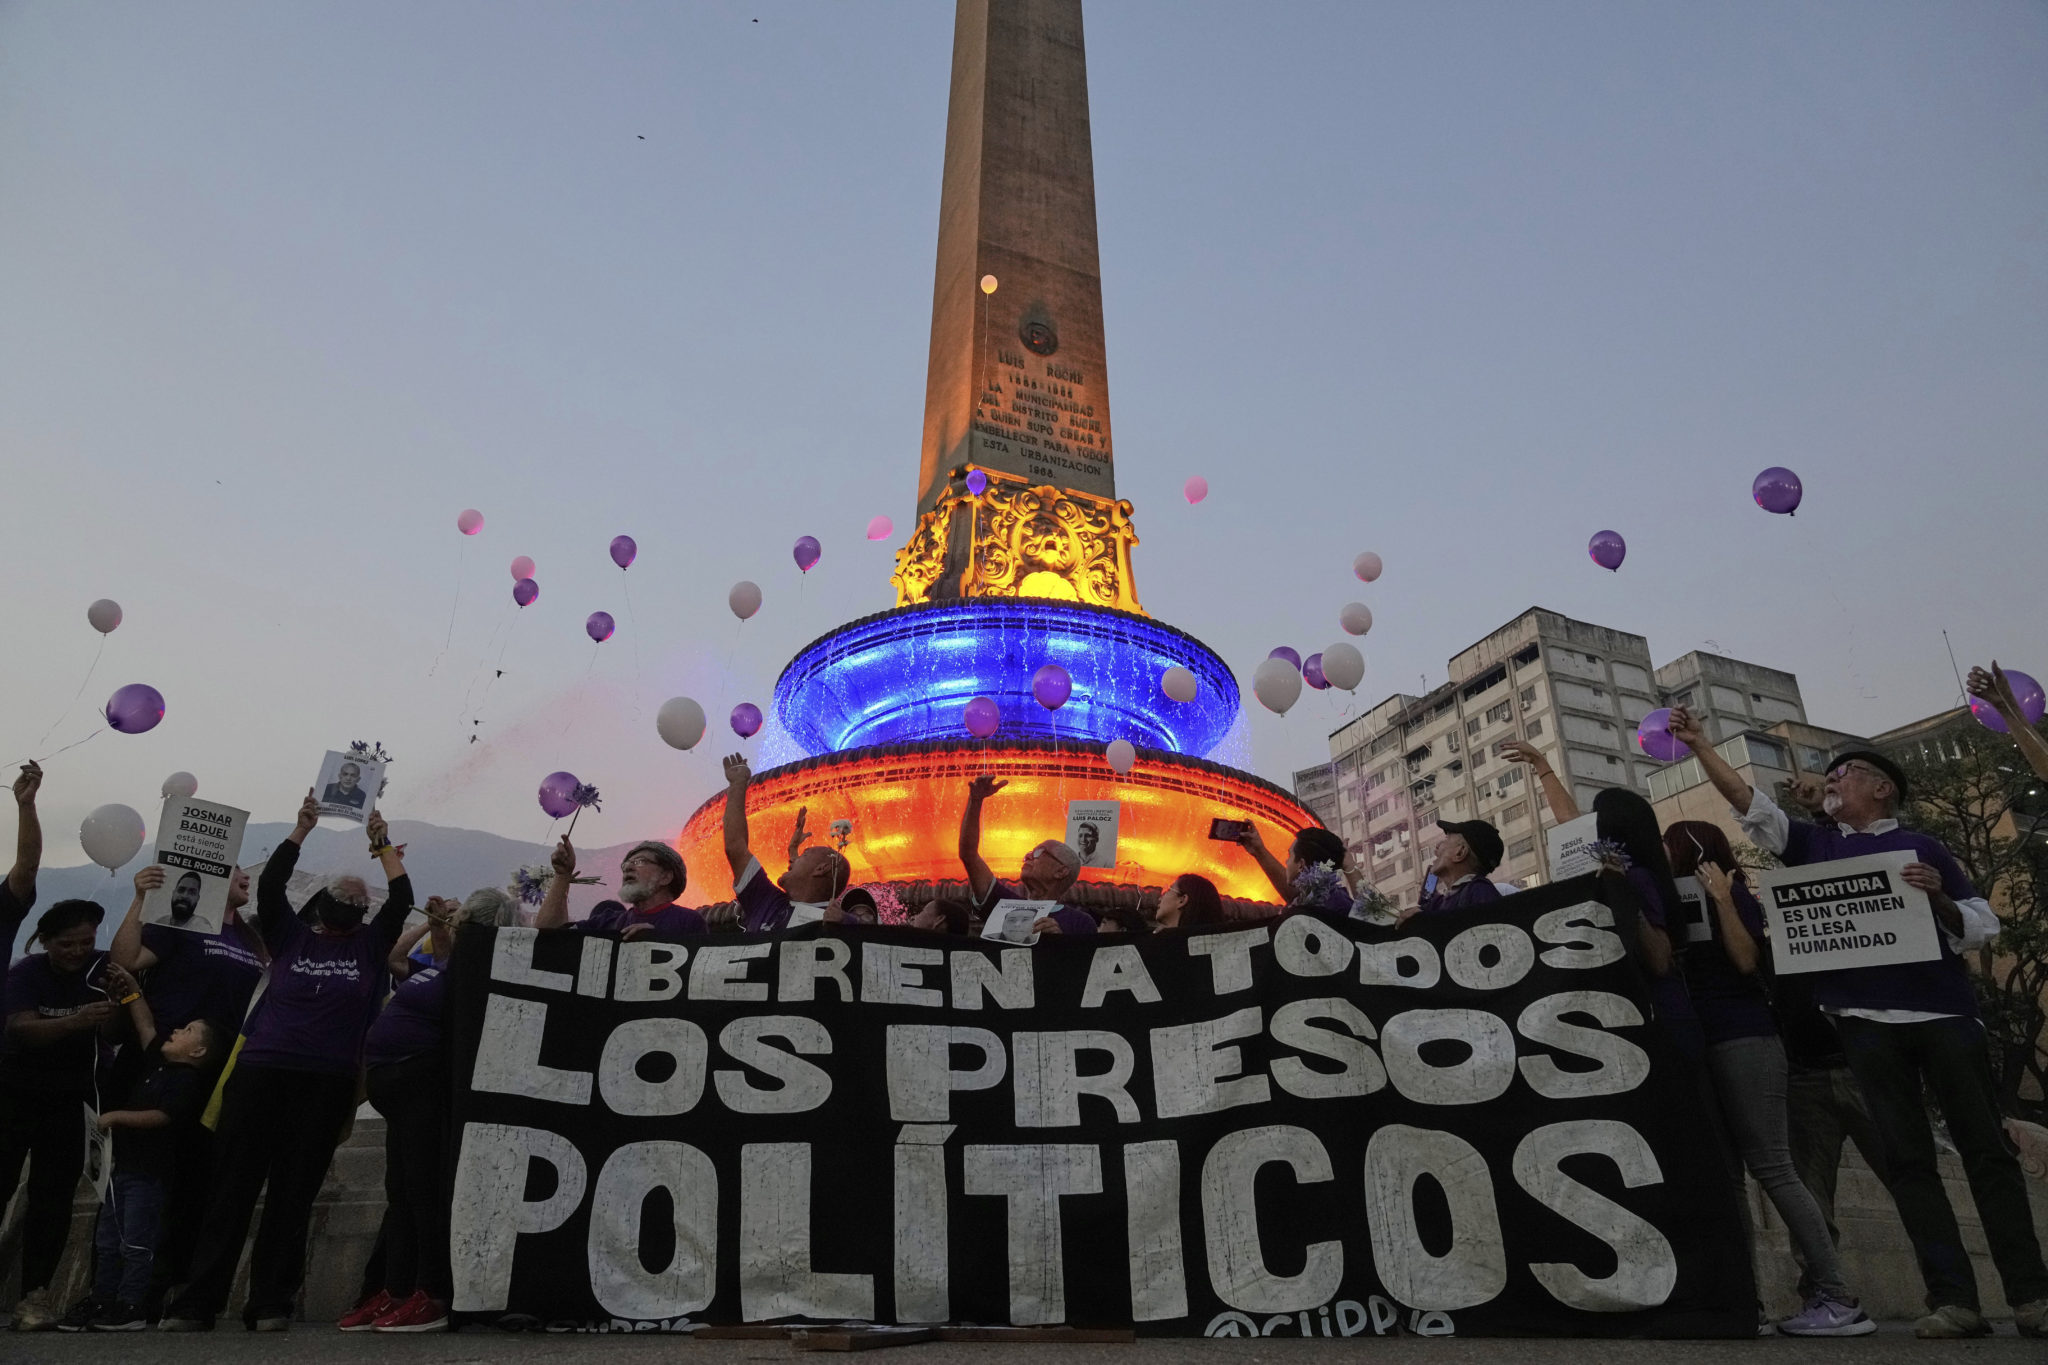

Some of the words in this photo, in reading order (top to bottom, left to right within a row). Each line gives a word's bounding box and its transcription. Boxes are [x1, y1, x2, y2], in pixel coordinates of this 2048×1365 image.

[998, 351, 1025, 369] LUIS
[1046, 363, 1084, 385] ROCHE
[1012, 402, 1059, 423] DISTRITO
[1015, 389, 1095, 417] MUNICIPALIDAD
[990, 408, 1021, 427] QUIEN
[1027, 421, 1054, 436] SUPO
[1060, 430, 1094, 445] CREAR
[975, 422, 1038, 446] EMBELLECER
[1043, 439, 1071, 455] PARA
[1076, 446, 1110, 464] TODOS
[983, 438, 1010, 453] ESTA
[1020, 447, 1101, 475] URBANIZACION
[180, 820, 229, 839] BADUEL
[182, 806, 233, 826] JOSNAR
[174, 842, 225, 861] torturado
[176, 834, 195, 843] está
[198, 838, 225, 850] siendo
[1560, 844, 1586, 859] ARMAS
[167, 855, 180, 865] EN
[182, 859, 192, 867] EL
[194, 861, 225, 875] RODEO
[1776, 887, 1801, 903] LA
[1801, 876, 1885, 899] TORTURA
[1783, 909, 1804, 923] ES
[1807, 905, 1832, 920] UN
[1835, 896, 1905, 917] CRIMEN
[1786, 925, 1809, 939] DE
[1811, 920, 1857, 936] LESA
[490, 926, 1036, 1010] LIBEREN
[1080, 944, 1162, 1008] A
[1187, 900, 1626, 995] TODOS
[1789, 932, 1897, 955] HUMANIDAD
[471, 993, 833, 1117] LOS
[886, 990, 1651, 1128] PRESOS
[449, 1119, 1678, 1328] POLÍTICOS
